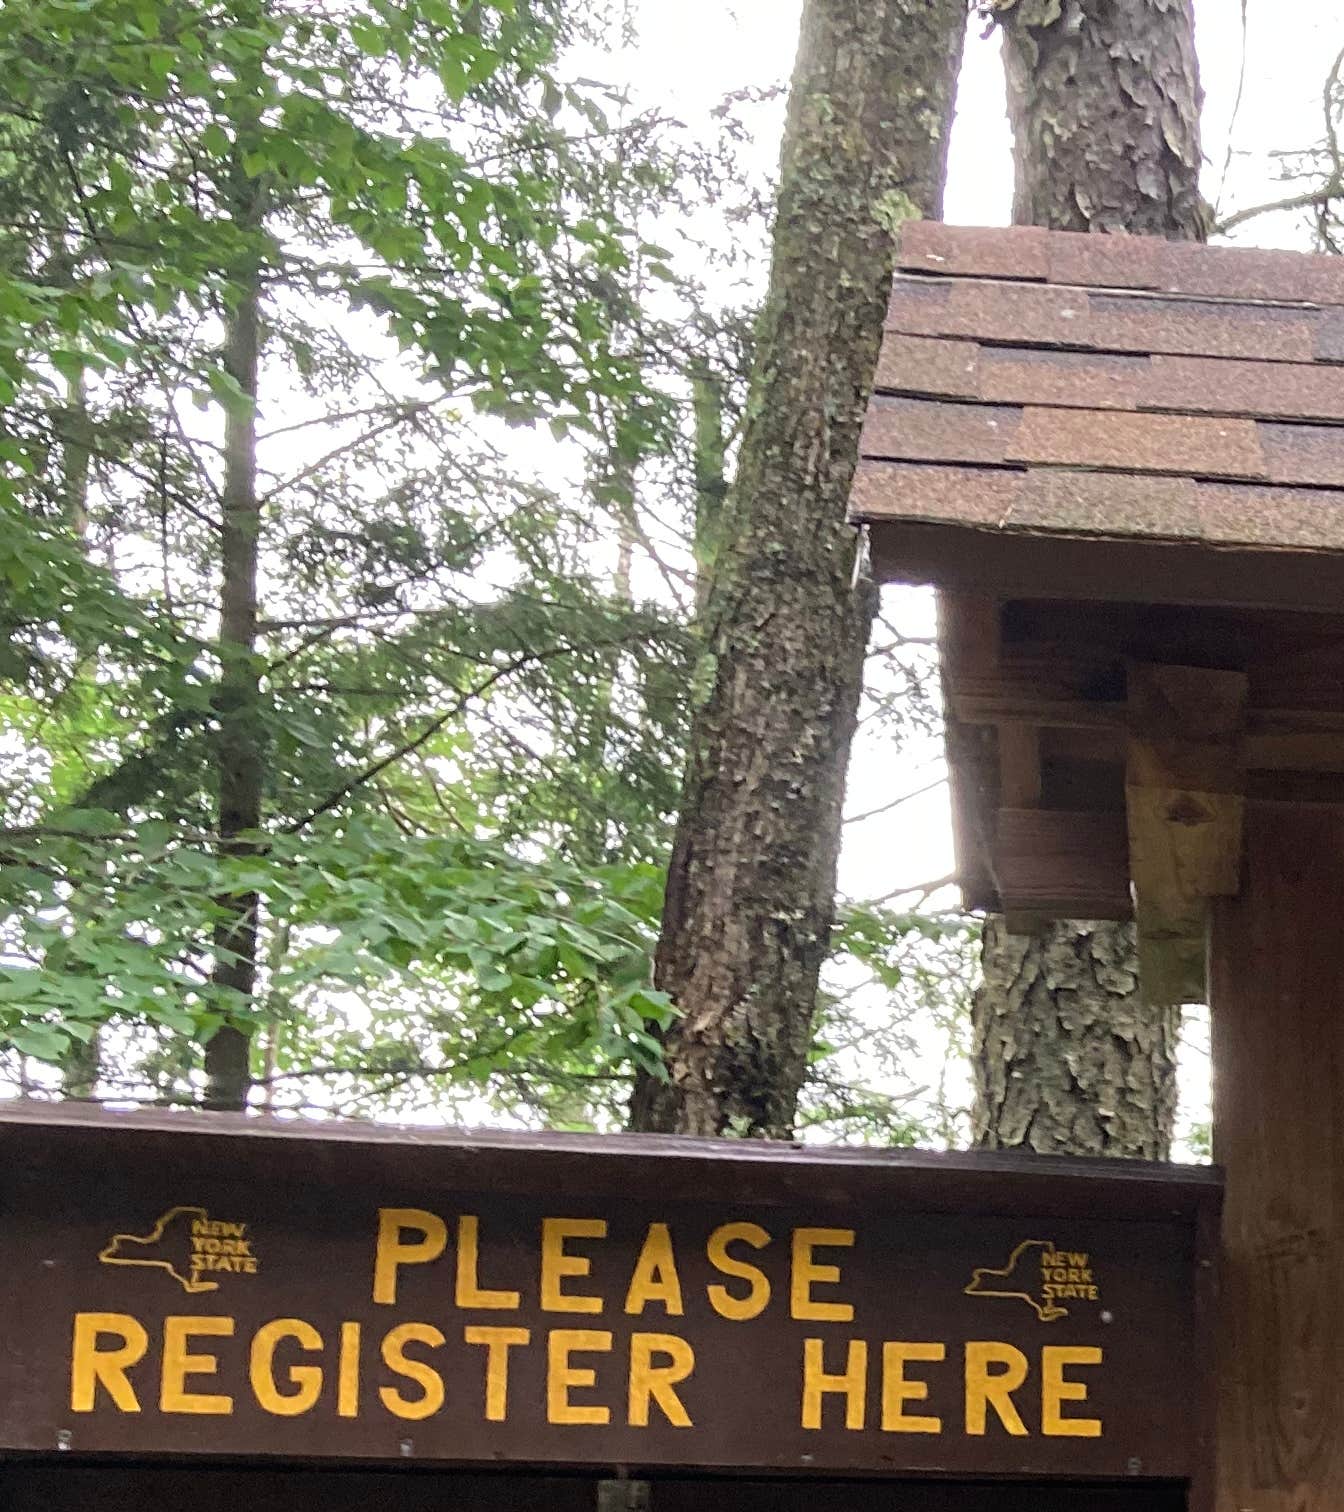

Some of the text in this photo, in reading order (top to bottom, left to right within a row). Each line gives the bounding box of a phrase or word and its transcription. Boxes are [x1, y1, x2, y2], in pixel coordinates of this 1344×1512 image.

[192, 1219, 246, 1236] NEW
[191, 1237, 251, 1255] YORK
[191, 1255, 257, 1272] STATE
[372, 1208, 855, 1323] PLEASE
[1041, 1252, 1089, 1267] NEW
[1041, 1268, 1093, 1282] YORK
[1041, 1284, 1098, 1300] STATE
[70, 1311, 1104, 1437] REGISTER HERE
